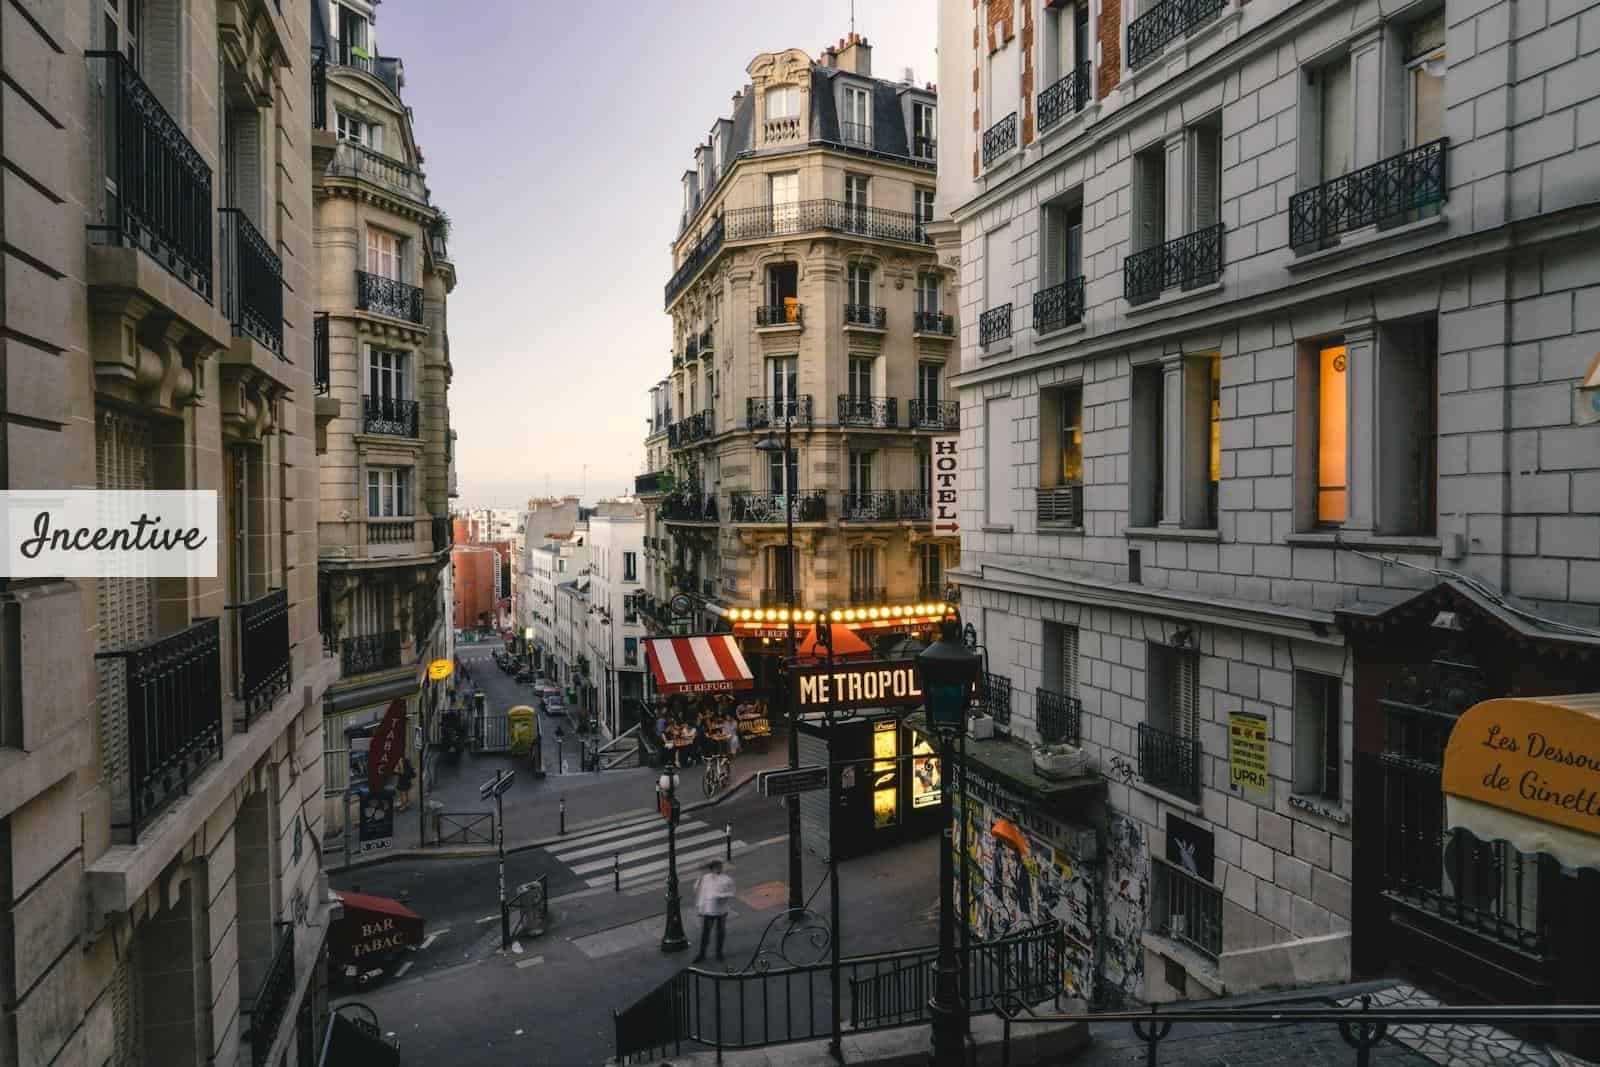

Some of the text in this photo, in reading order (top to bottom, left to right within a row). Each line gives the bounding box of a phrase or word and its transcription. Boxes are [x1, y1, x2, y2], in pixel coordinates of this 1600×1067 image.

[935, 440, 958, 520] HOTEL
[679, 681, 734, 693] LE REFUGE
[800, 668, 975, 705] METROPOL
[1482, 725, 1520, 753] Les
[1482, 762, 1511, 791] de
[361, 918, 395, 938] BAR
[351, 932, 404, 958] TABAC
